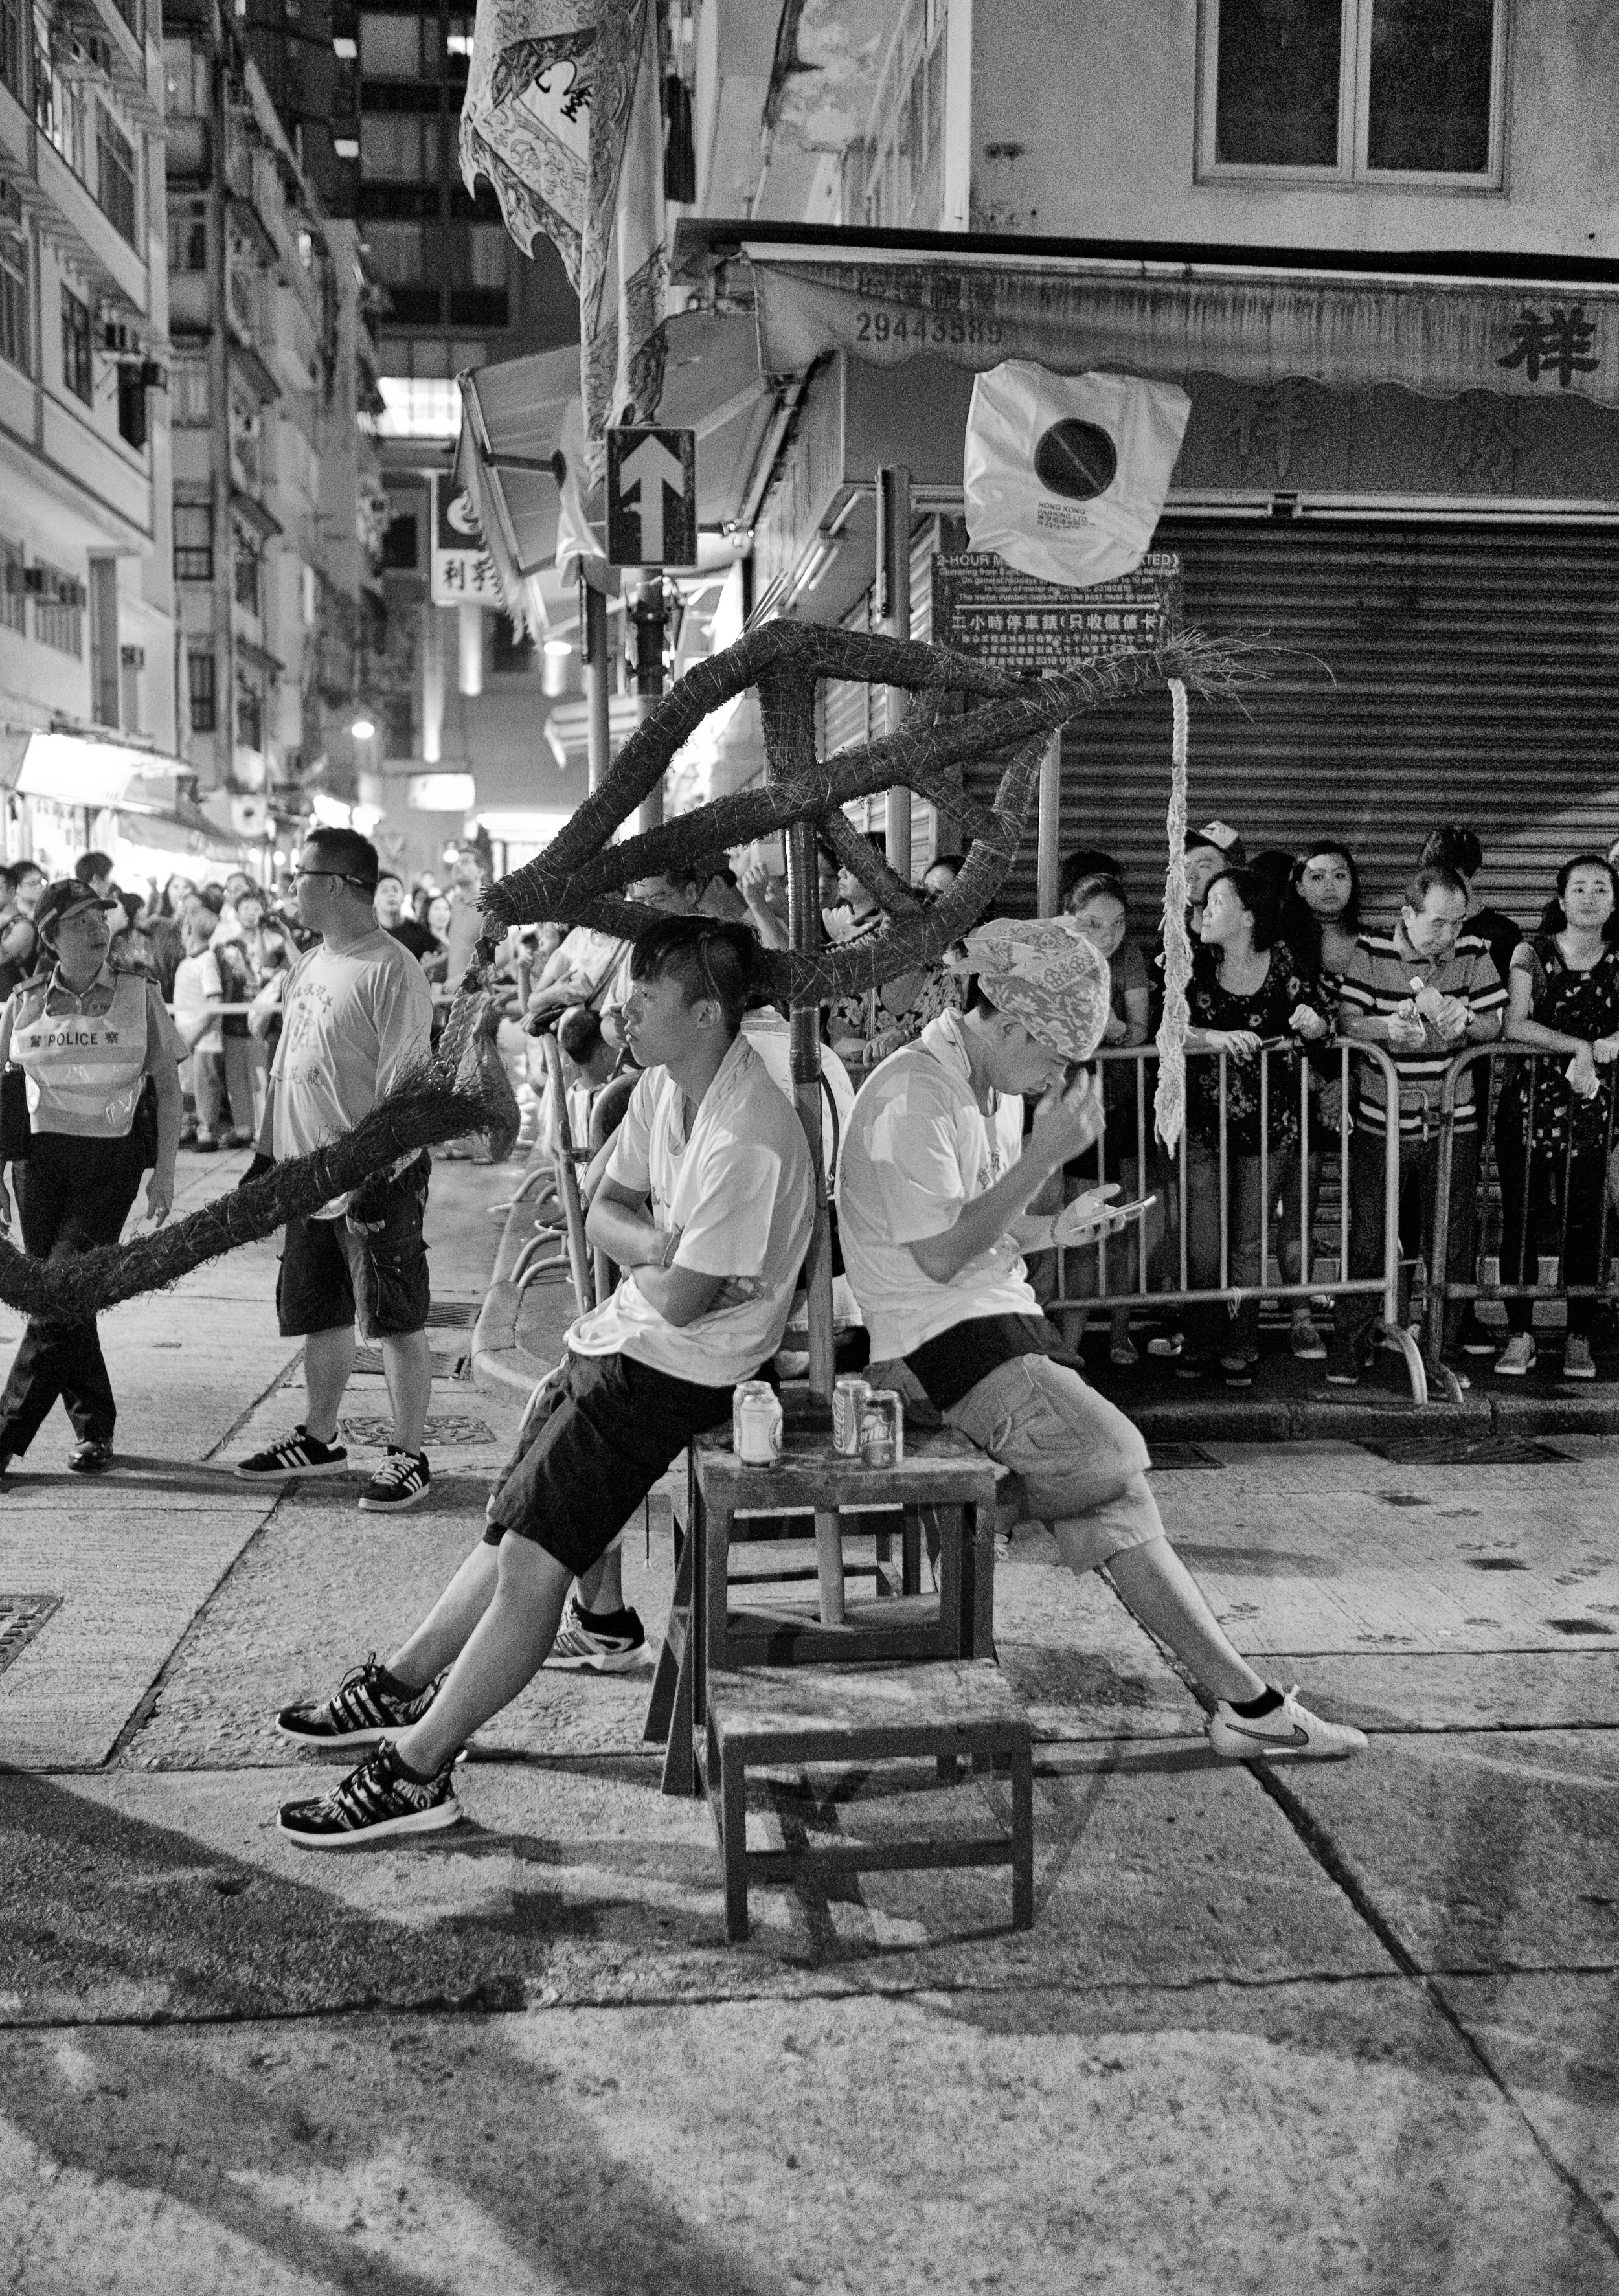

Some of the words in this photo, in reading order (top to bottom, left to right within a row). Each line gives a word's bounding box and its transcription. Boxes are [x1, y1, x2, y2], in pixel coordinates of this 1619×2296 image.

[1497, 306, 1600, 387] 祥
[1037, 501, 1061, 510] HONG
[1063, 505, 1085, 515] KONG
[1037, 509, 1072, 520] PARKING
[936, 554, 989, 565] 2-HOUR
[48, 1031, 98, 1046] POLICE
